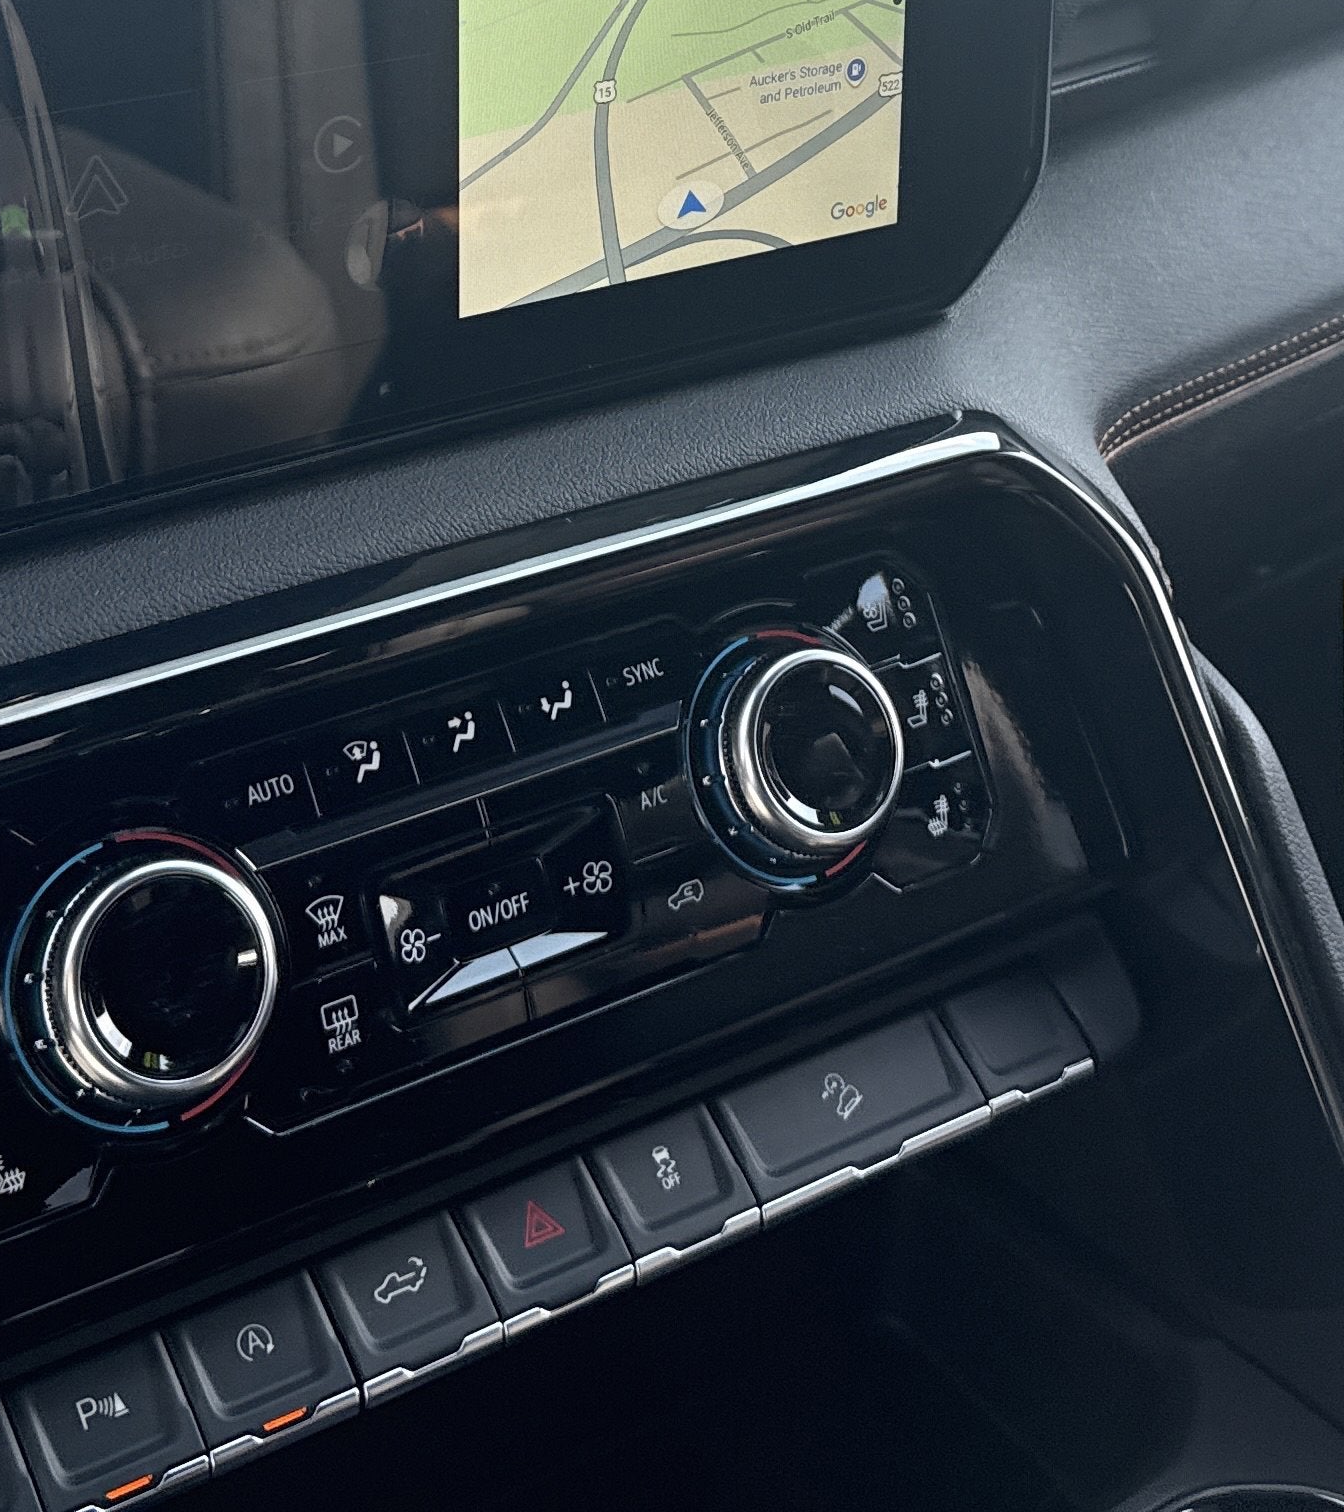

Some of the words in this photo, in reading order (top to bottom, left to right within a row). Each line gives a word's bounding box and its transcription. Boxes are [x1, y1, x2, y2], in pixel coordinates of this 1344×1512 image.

[794, 19, 812, 36] Old
[814, 9, 836, 29] Trail
[749, 67, 797, 89] Aucker's
[799, 61, 844, 80] Storage
[881, 79, 900, 94] 522
[598, 86, 612, 99] 15
[759, 89, 782, 106] and
[784, 80, 842, 101] Petroleum
[706, 108, 740, 154] Jefferson
[734, 149, 750, 172] Ave
[830, 194, 889, 220] Google
[622, 658, 665, 687] SYNC
[248, 774, 295, 806] AUTO
[641, 784, 669, 811] A/C
[468, 891, 531, 932] ON/OFF
[317, 926, 348, 949] MAX
[327, 1029, 362, 1055] REAR
[661, 1171, 681, 1190] OFF
